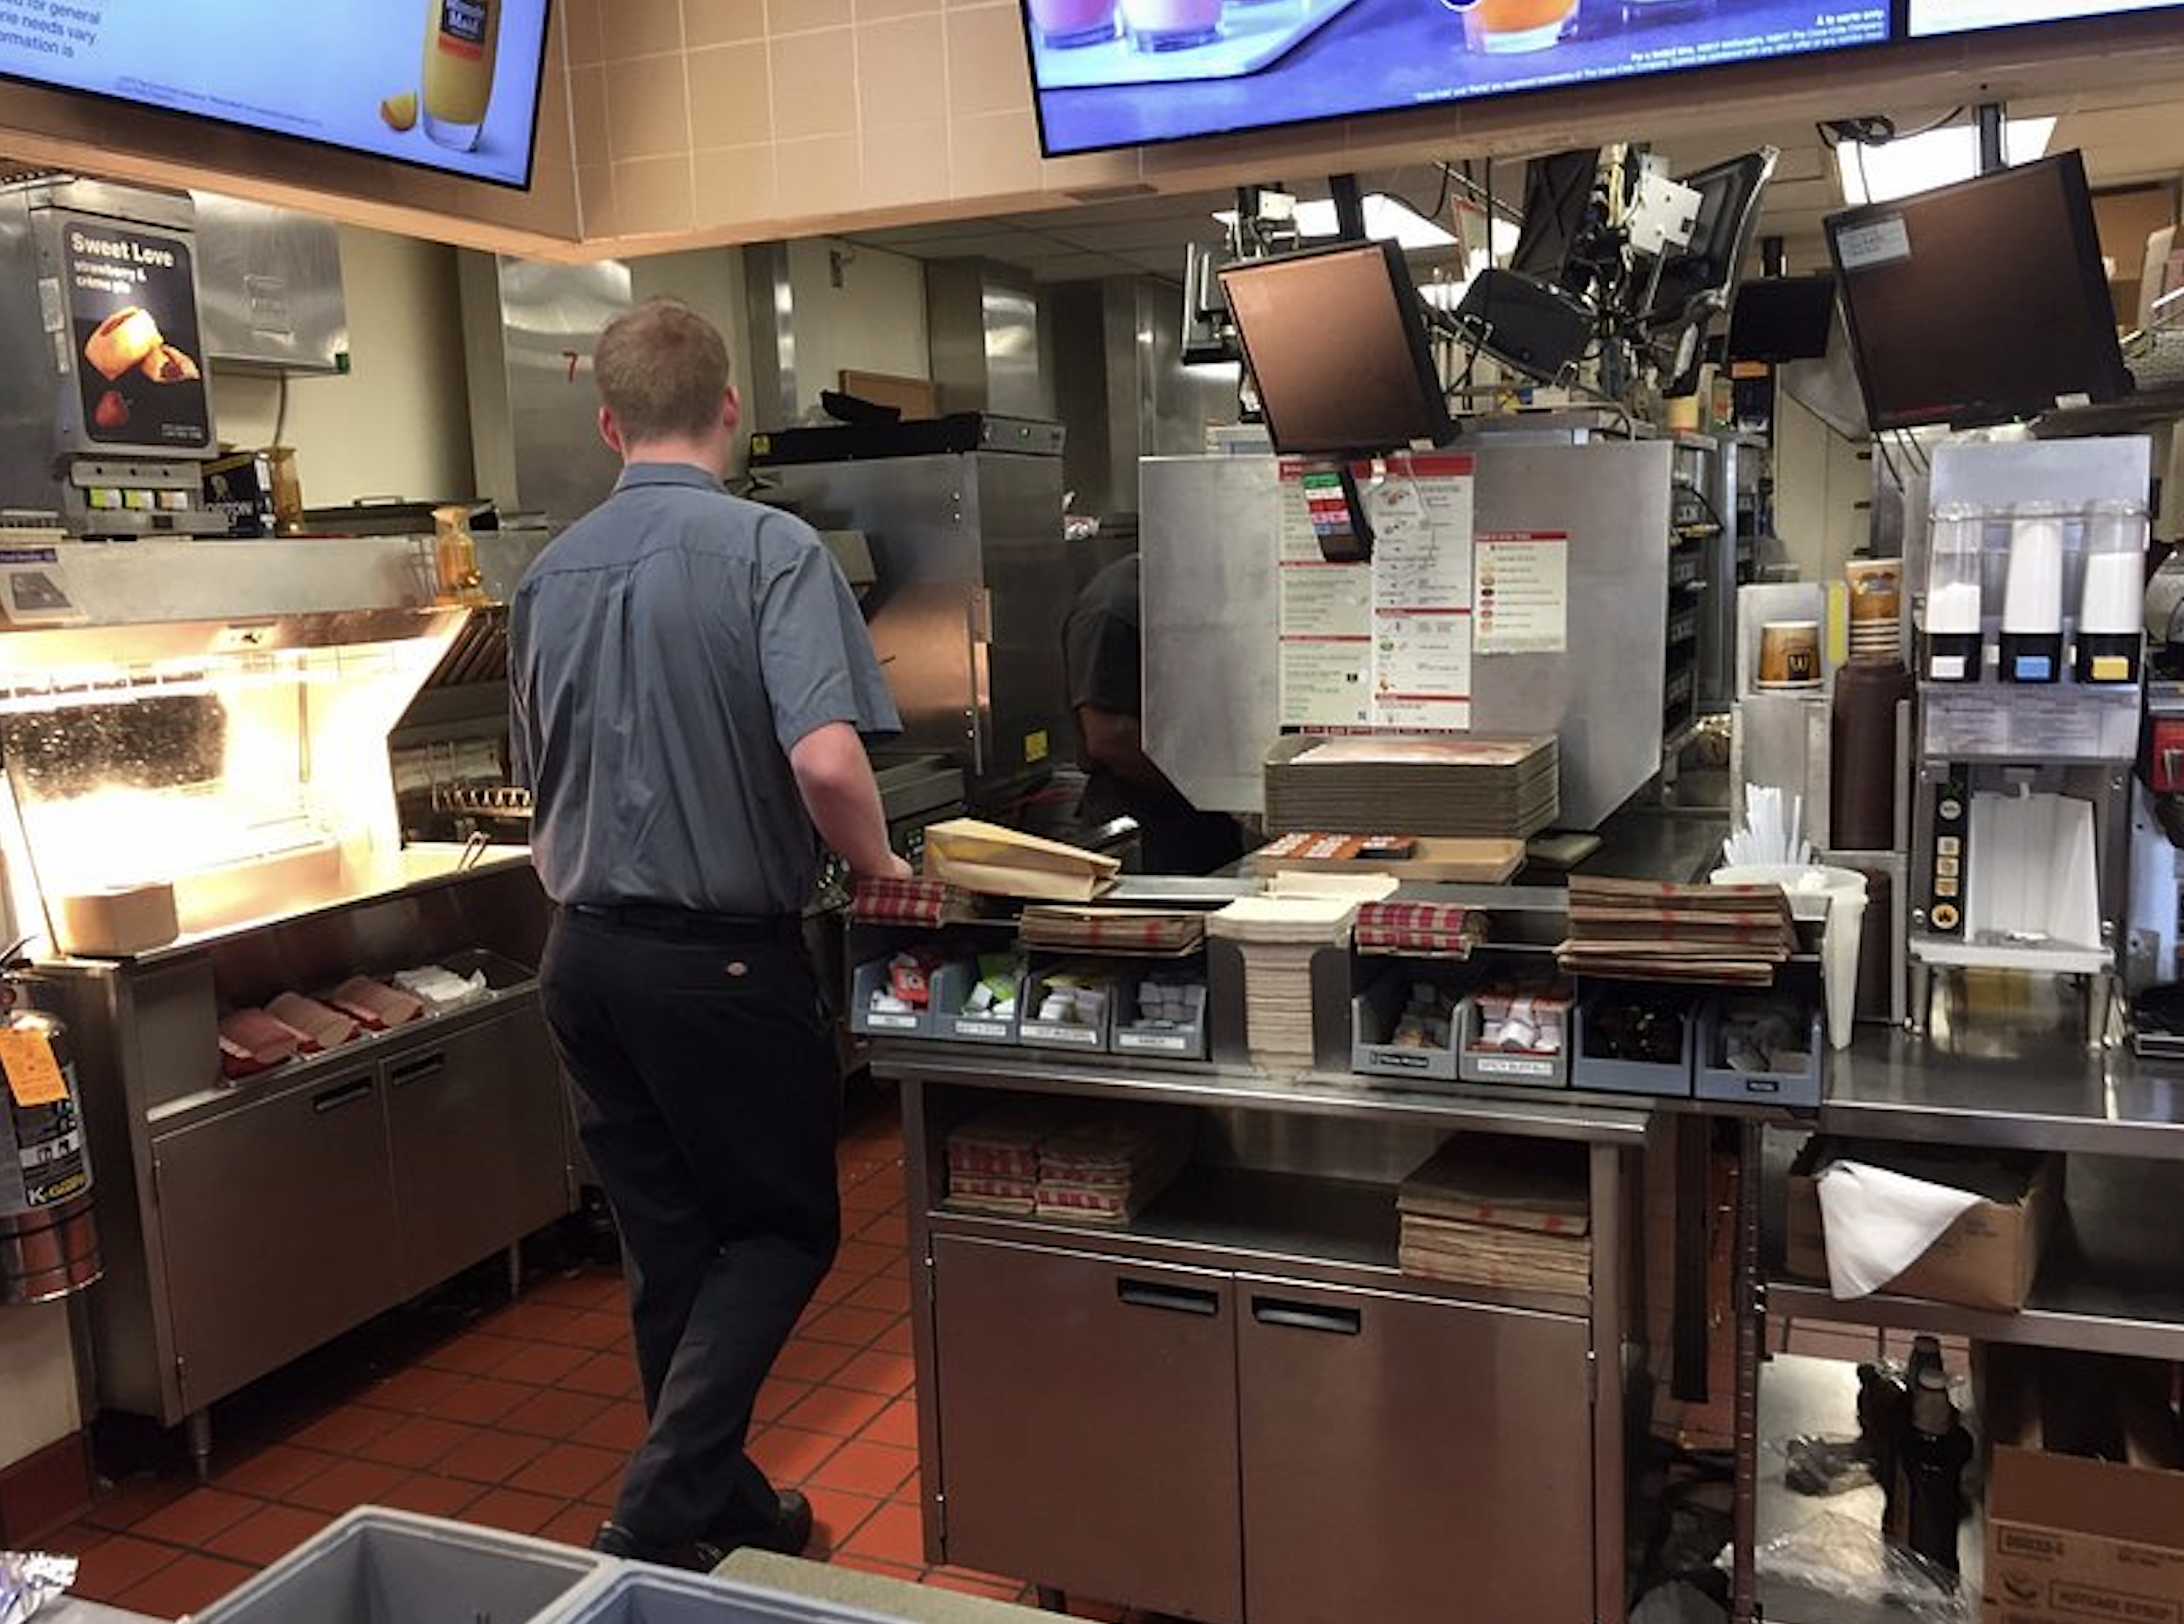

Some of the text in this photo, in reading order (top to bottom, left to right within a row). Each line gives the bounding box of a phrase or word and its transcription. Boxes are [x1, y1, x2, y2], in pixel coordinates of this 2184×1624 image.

[22, 16, 64, 36] needs
[49, 3, 101, 25] general
[71, 232, 174, 268] Sweet Love
[562, 351, 578, 384] 7
